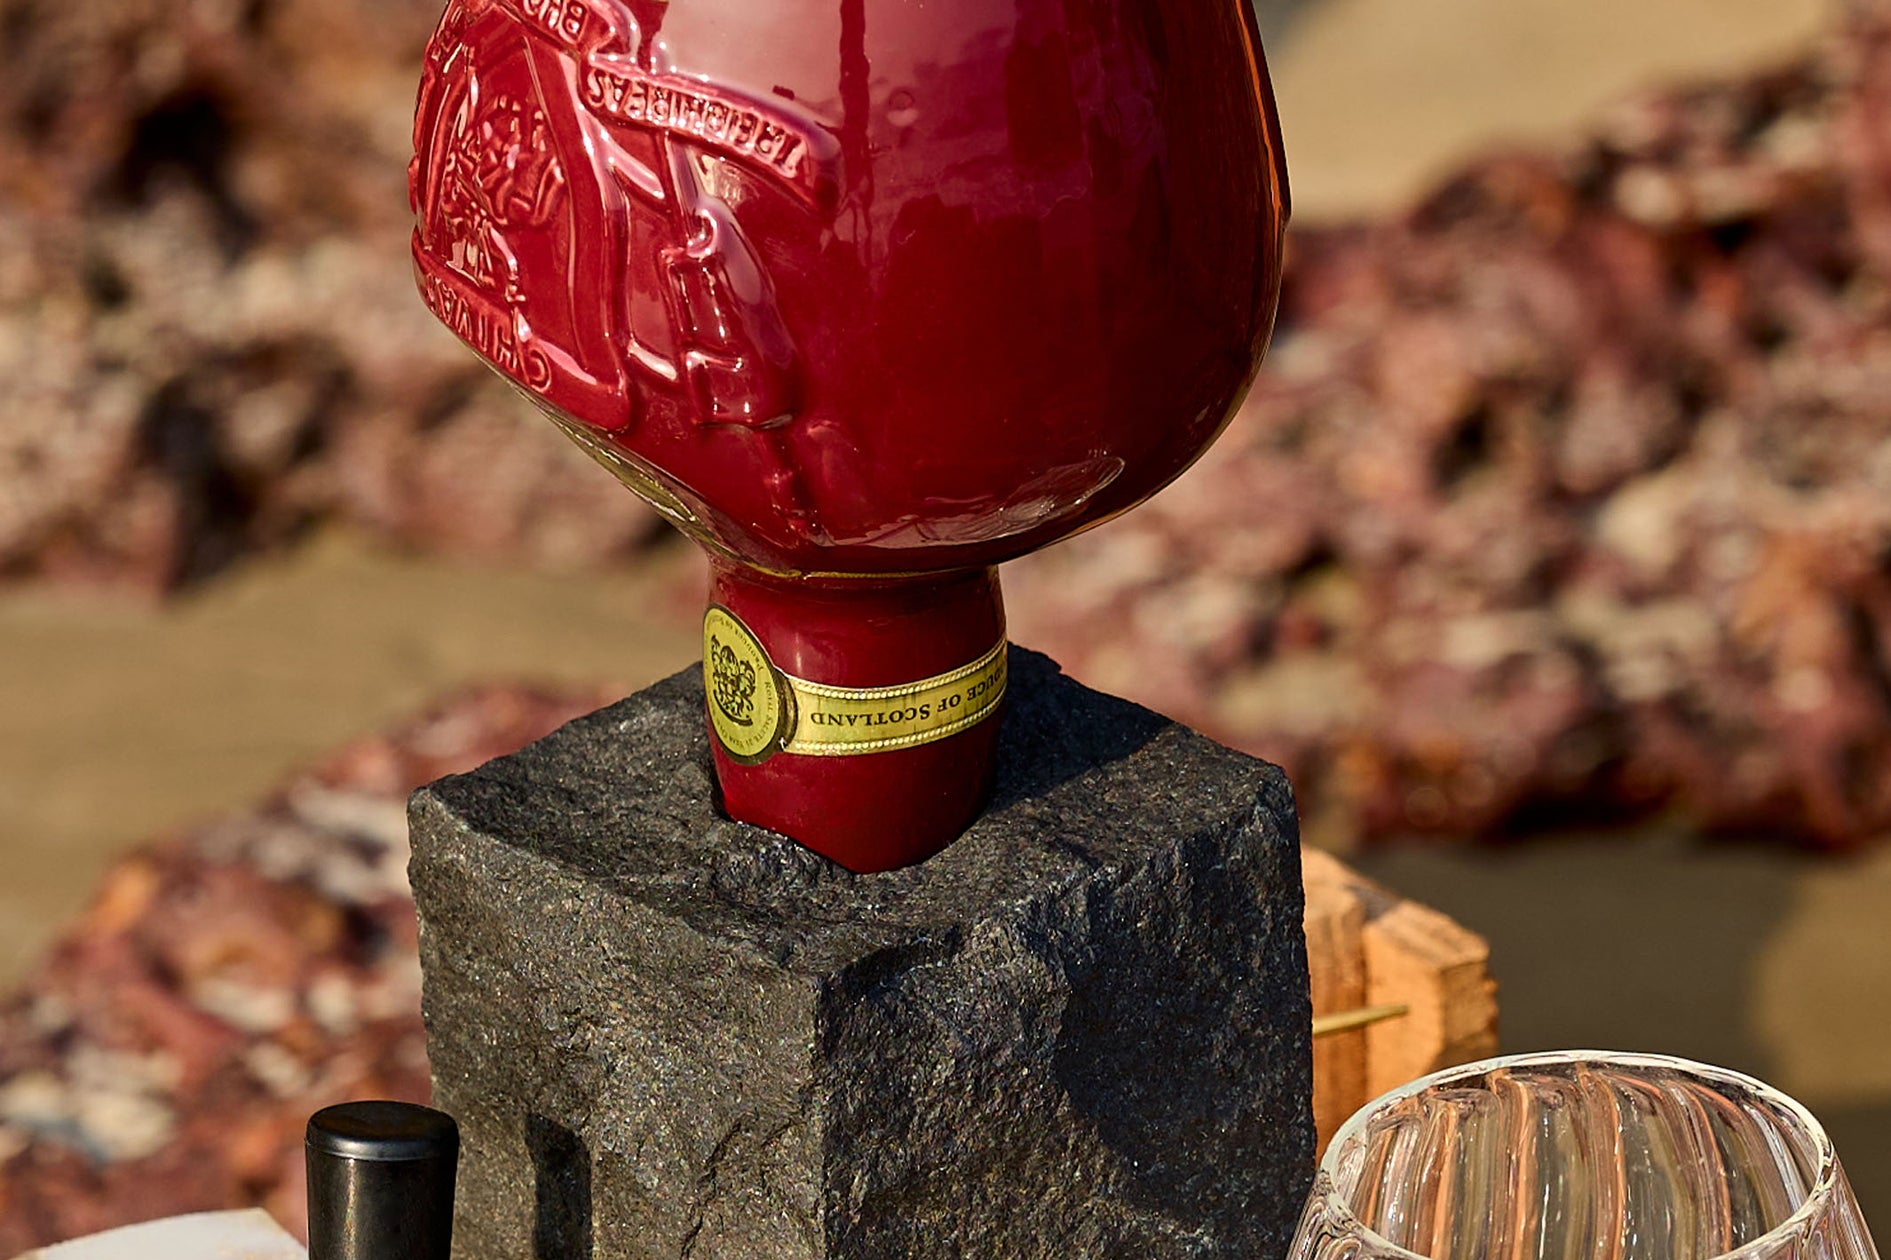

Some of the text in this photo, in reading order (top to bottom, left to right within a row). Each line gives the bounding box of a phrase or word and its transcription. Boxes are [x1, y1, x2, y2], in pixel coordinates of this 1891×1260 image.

[810, 668, 1003, 727] DUCE OF SCOTLAND
